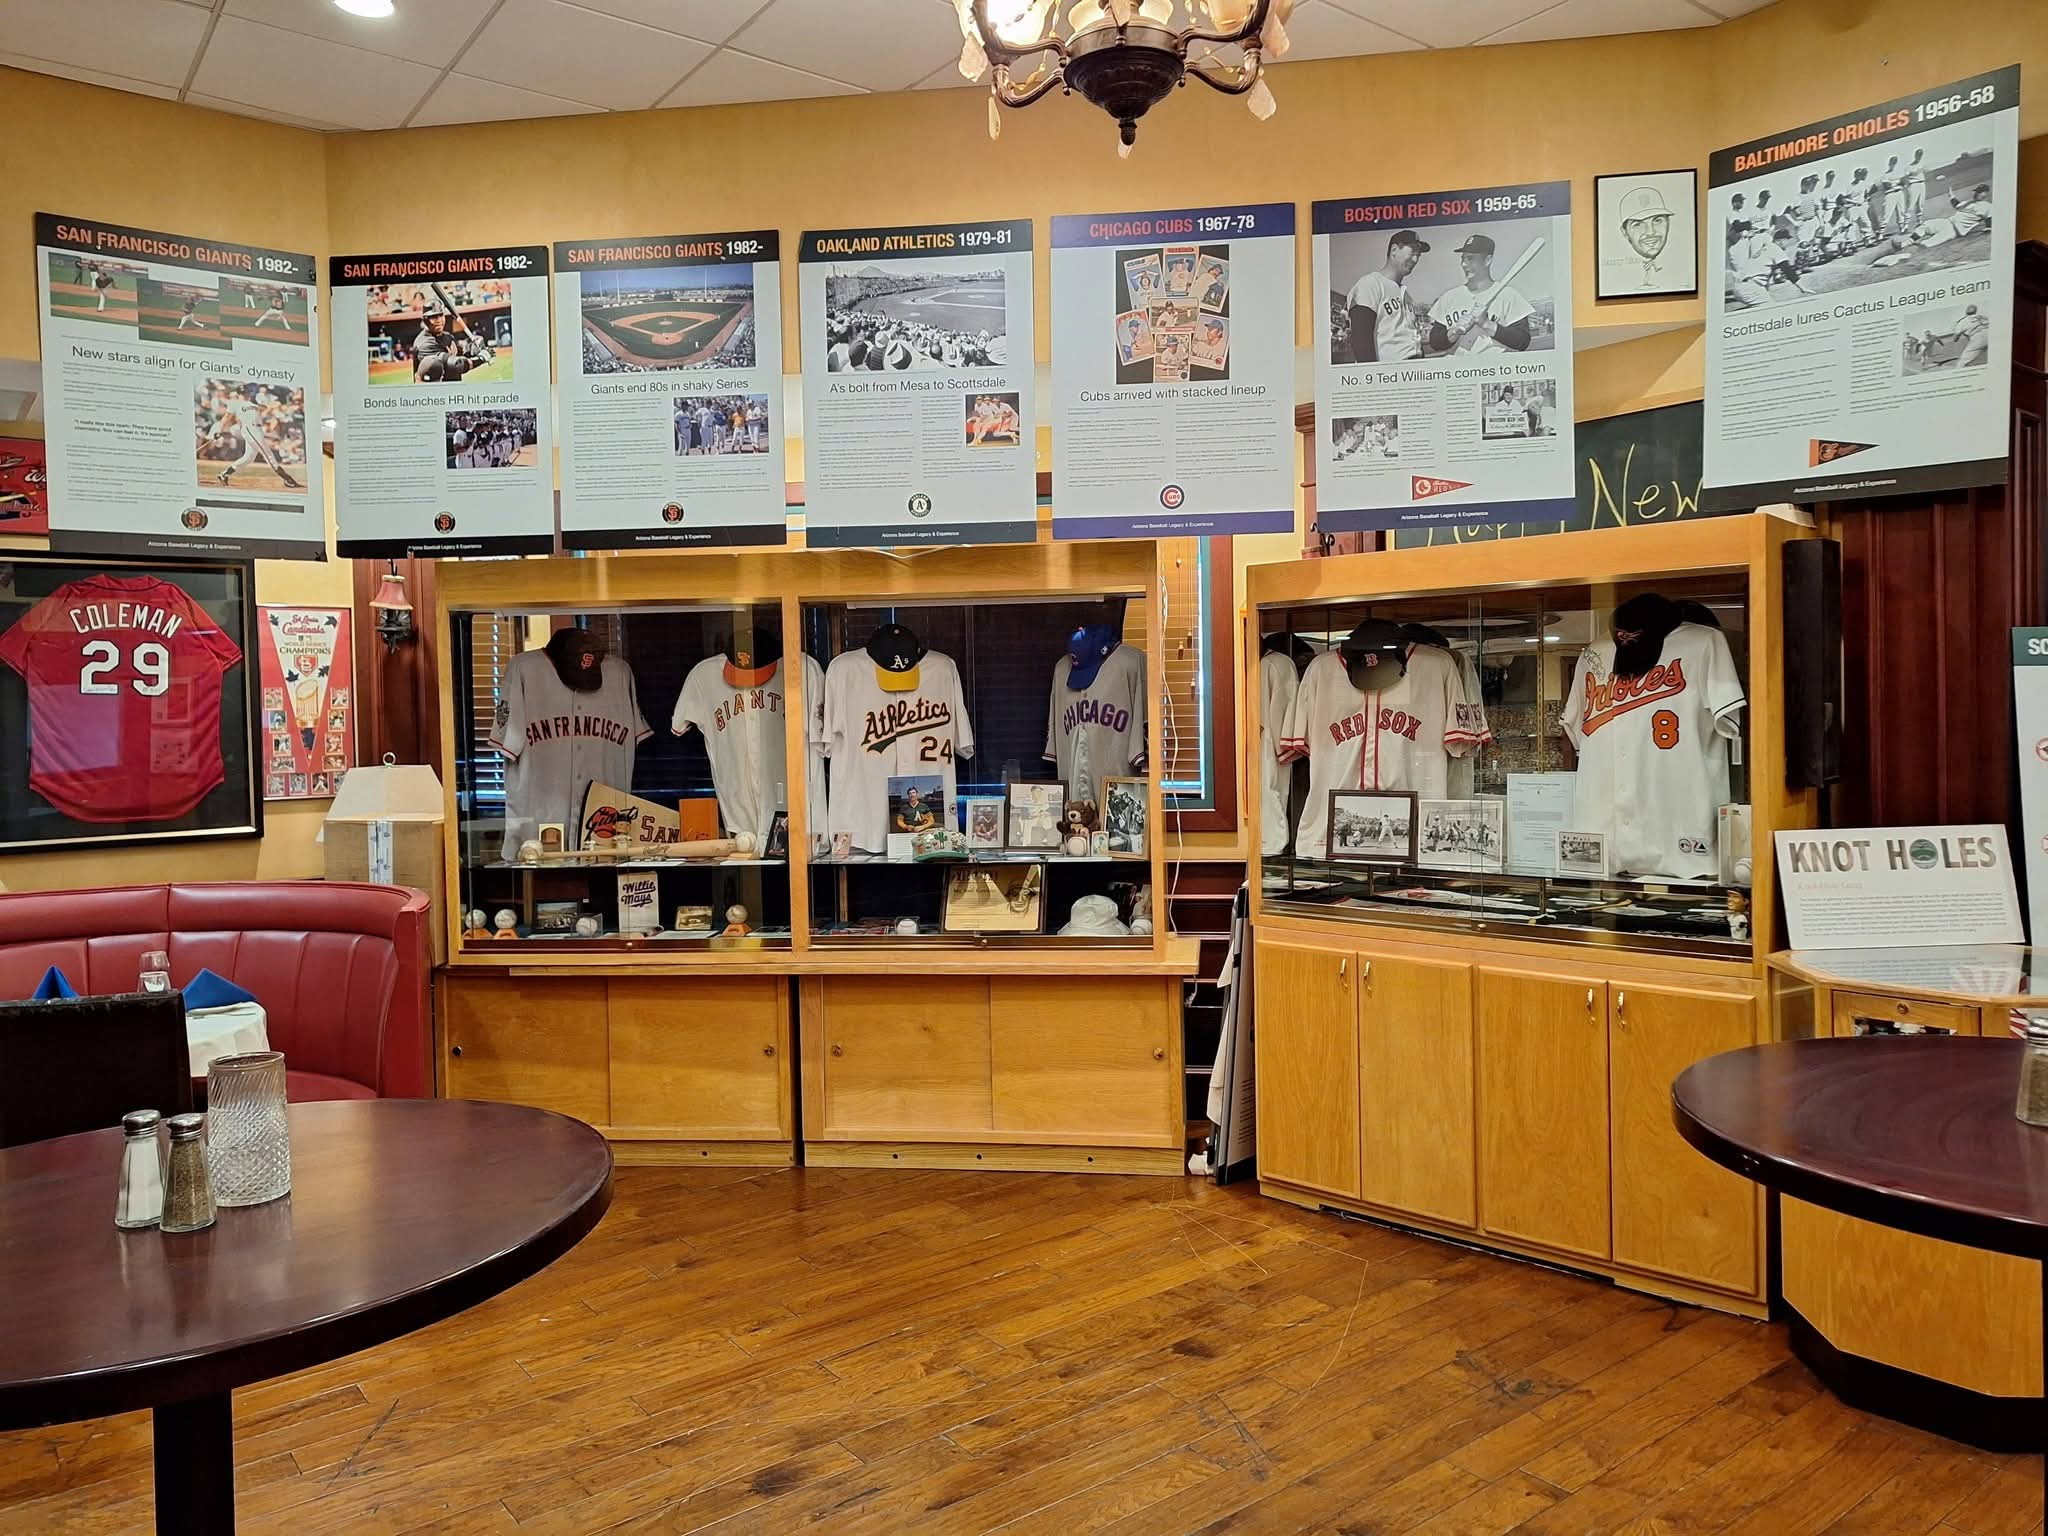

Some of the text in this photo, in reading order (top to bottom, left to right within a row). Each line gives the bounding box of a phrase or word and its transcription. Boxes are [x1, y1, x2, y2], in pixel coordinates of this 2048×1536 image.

[1734, 85, 1996, 173] BALTIMORE ORIOLES 1956-58
[1344, 194, 1537, 223] BOSTON RED SOX 1959-65
[1089, 214, 1255, 238] CHICAGO CUBS 1967-78
[56, 224, 299, 275] SAN FRANCISCO GIANTS 1982-
[568, 240, 764, 263] SAN FRANCISCO GIANTS 1982-
[816, 229, 1012, 254] OAKLAND ATHLETICS 1979-81
[343, 255, 533, 278] SAN FRANCISCO GIANTS 1982-
[1723, 279, 1991, 339] Scottsdale lures Cactus League team
[72, 345, 295, 382] New stars align for Giants' dynasty
[1341, 363, 1546, 386] No. 9 Ted Williams comes to town
[364, 392, 519, 408] Bonds launches HR hit parade
[591, 379, 749, 394] Giants end 80s in shaky Series
[830, 377, 1006, 393] A's bolt from Mesa to Scottsdale
[1080, 385, 1266, 402] Cubs arrived with stacked lineup
[1588, 443, 1704, 531] New
[69, 603, 183, 639] COLEMAN
[282, 622, 326, 636] Cardinals
[279, 646, 331, 655] CHAMPIONS
[80, 638, 170, 697] 29
[715, 689, 785, 732] GIANT
[861, 698, 951, 747] Athletics
[1063, 699, 1130, 737] CHICAGO
[526, 715, 629, 747] SAN FRANCISCO
[1329, 708, 1422, 746] RED SOX
[1651, 709, 1680, 750] 8
[920, 735, 953, 765] 24
[1788, 840, 1871, 873] KNOT
[621, 893, 653, 908] Mays
[623, 880, 656, 895] Willie
